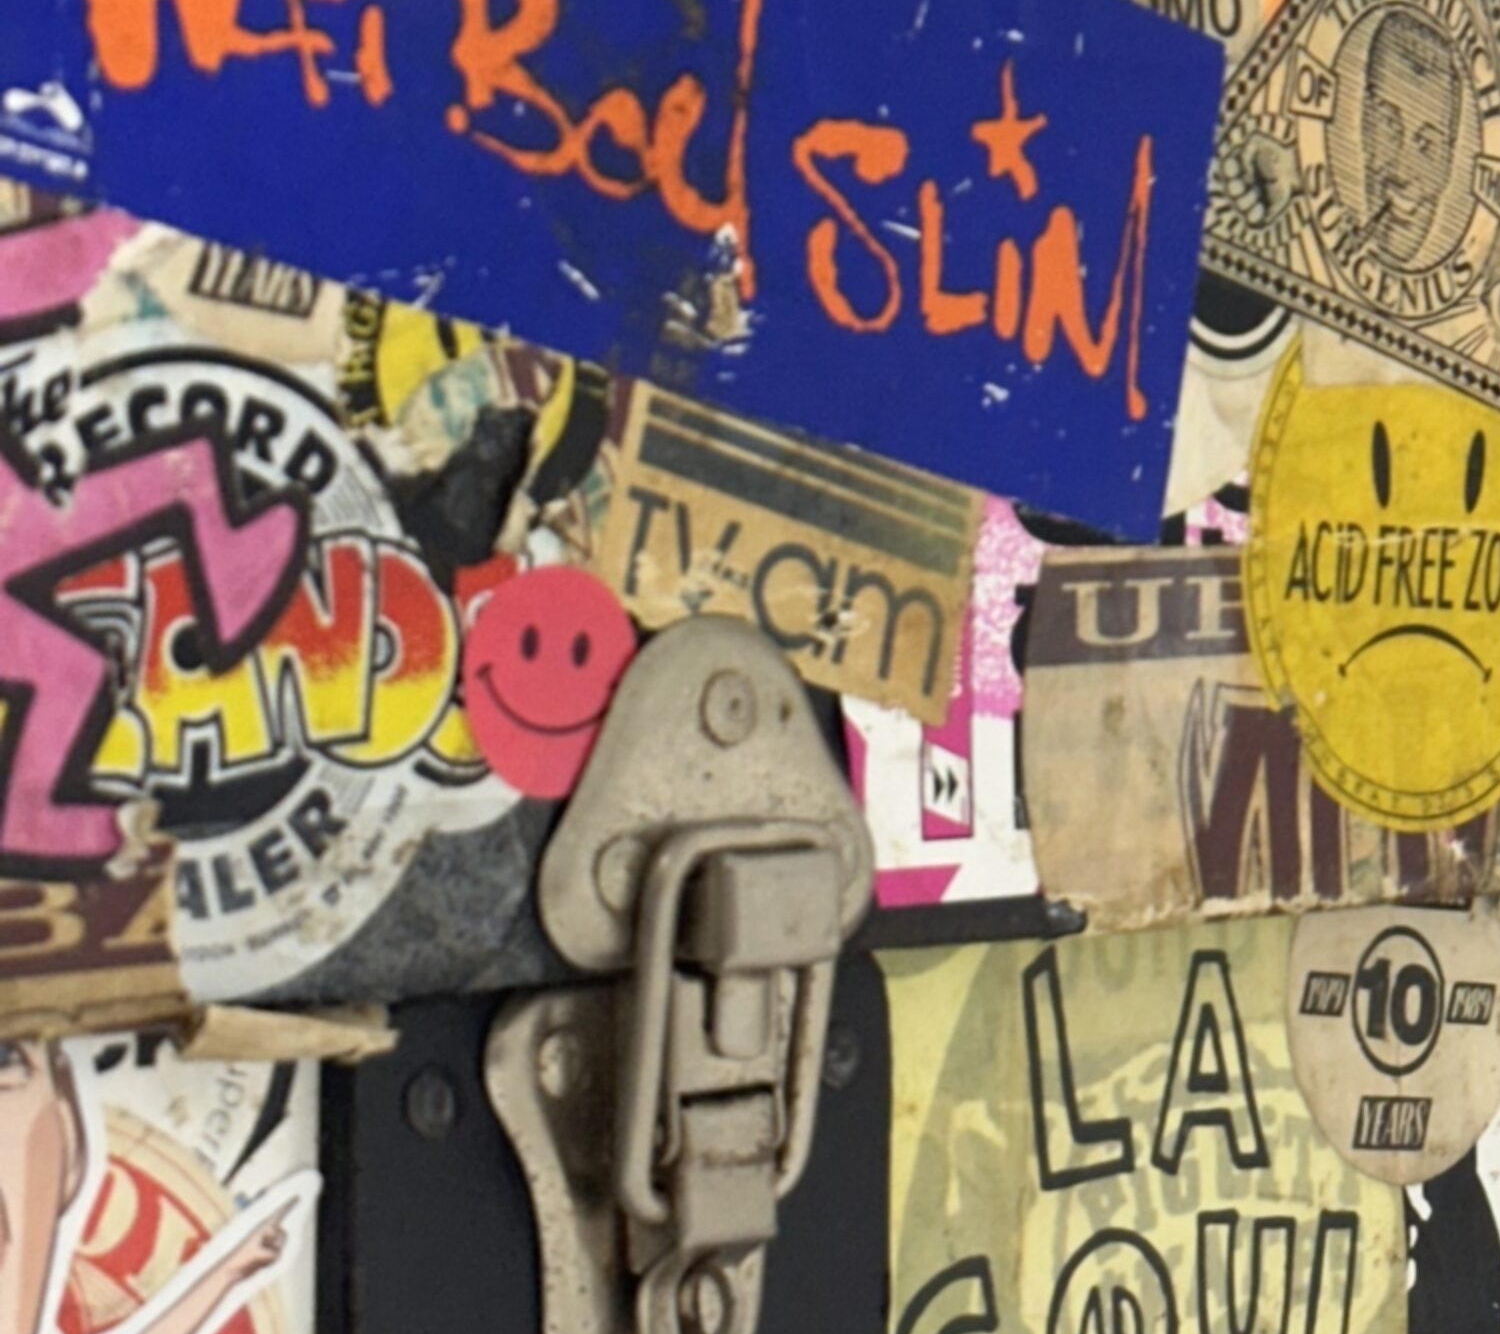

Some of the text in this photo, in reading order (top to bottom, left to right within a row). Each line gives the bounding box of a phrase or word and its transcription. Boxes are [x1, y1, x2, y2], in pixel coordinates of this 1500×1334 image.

[1298, 64, 1334, 108] OF
[1283, 519, 1370, 605] ACID
[1373, 524, 1460, 611] FREE
[1356, 957, 1439, 1046] 10
[1023, 943, 1270, 1191] LA
[1358, 1099, 1430, 1148] YEARS
